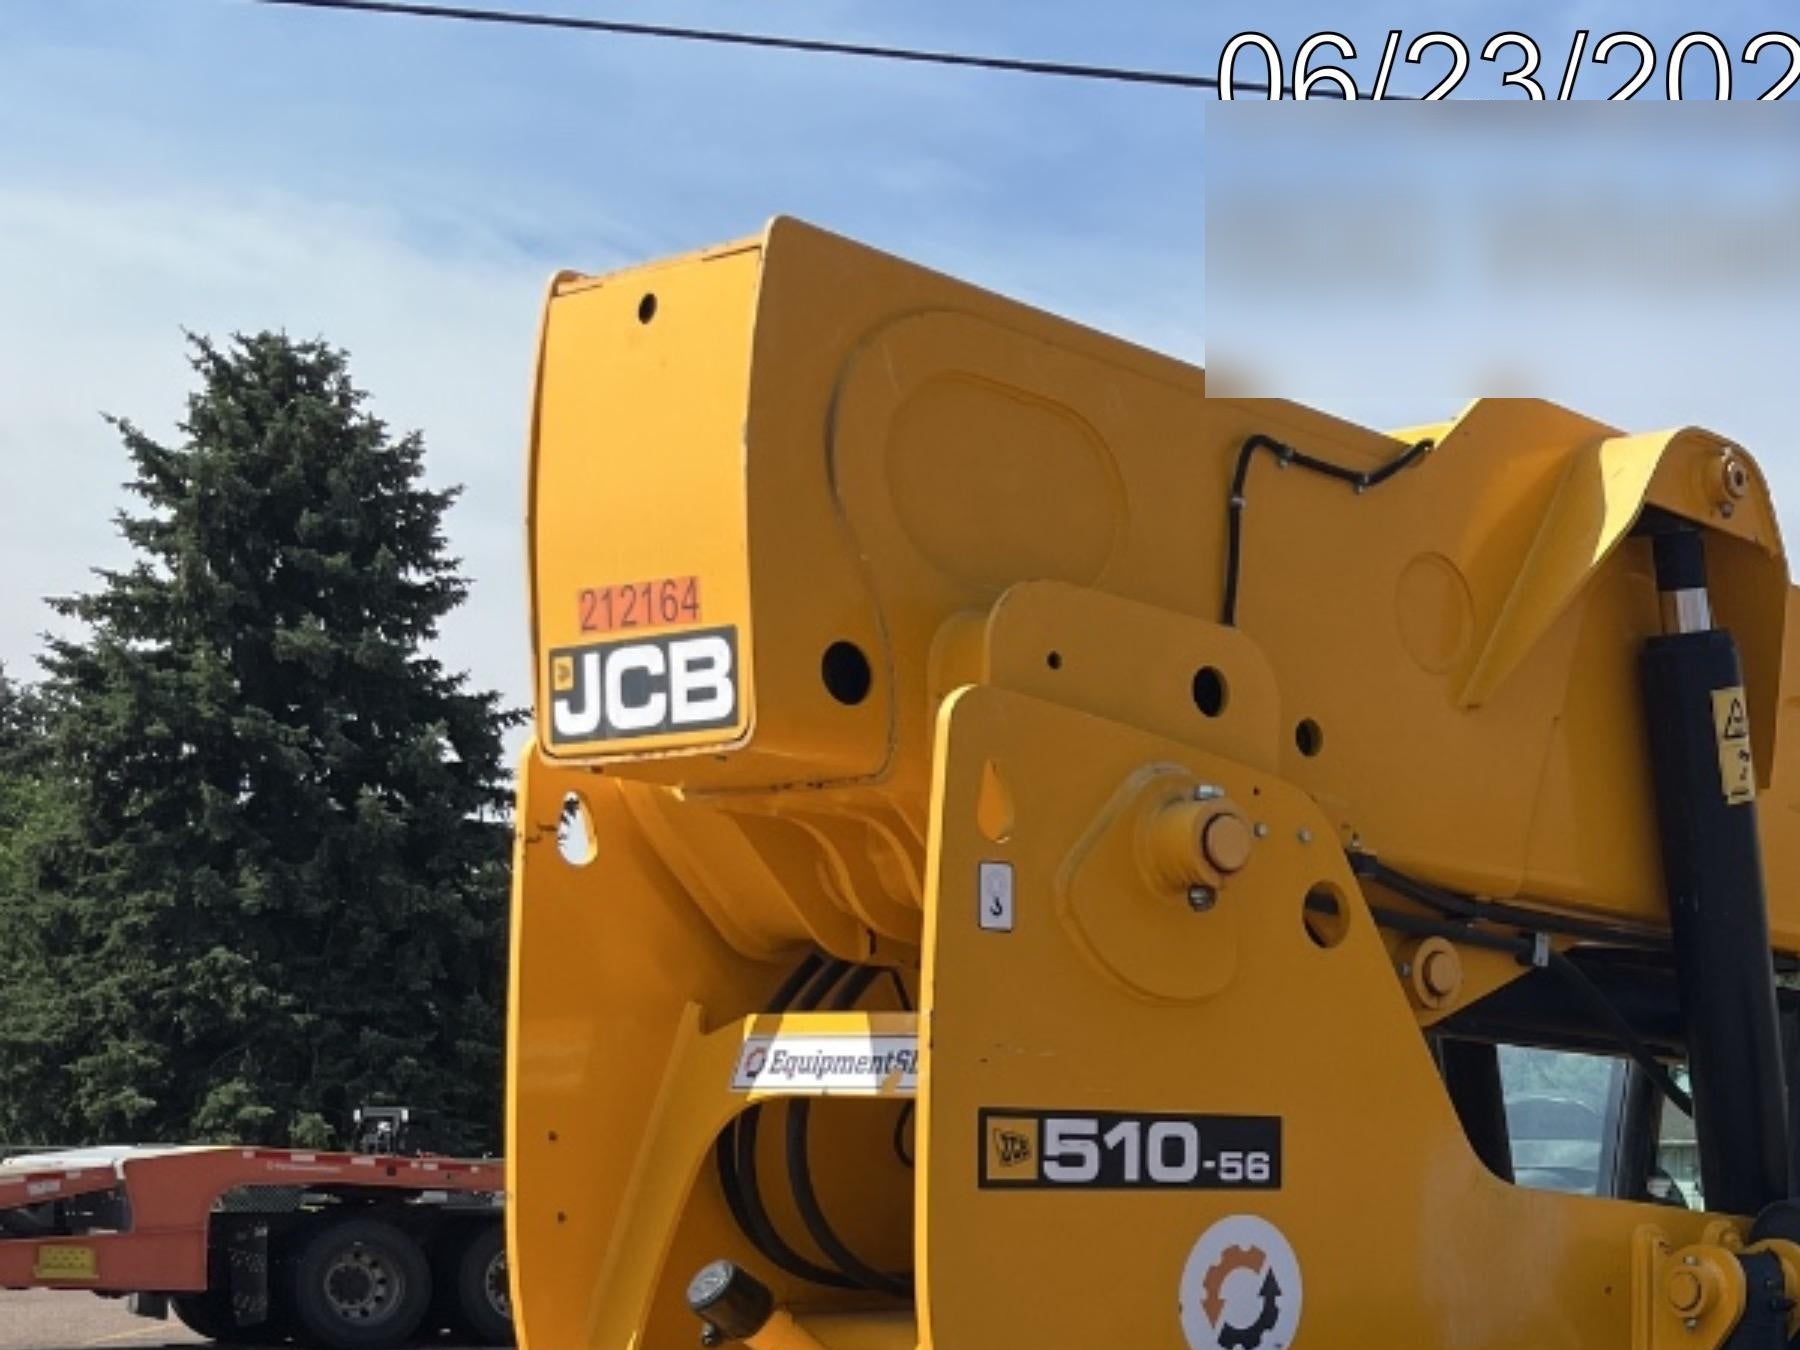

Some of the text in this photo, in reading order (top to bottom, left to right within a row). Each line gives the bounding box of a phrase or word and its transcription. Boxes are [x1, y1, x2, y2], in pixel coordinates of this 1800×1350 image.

[580, 577, 700, 633] 212164
[553, 635, 735, 737] JCB
[1042, 1118, 1271, 1183] 510-56
